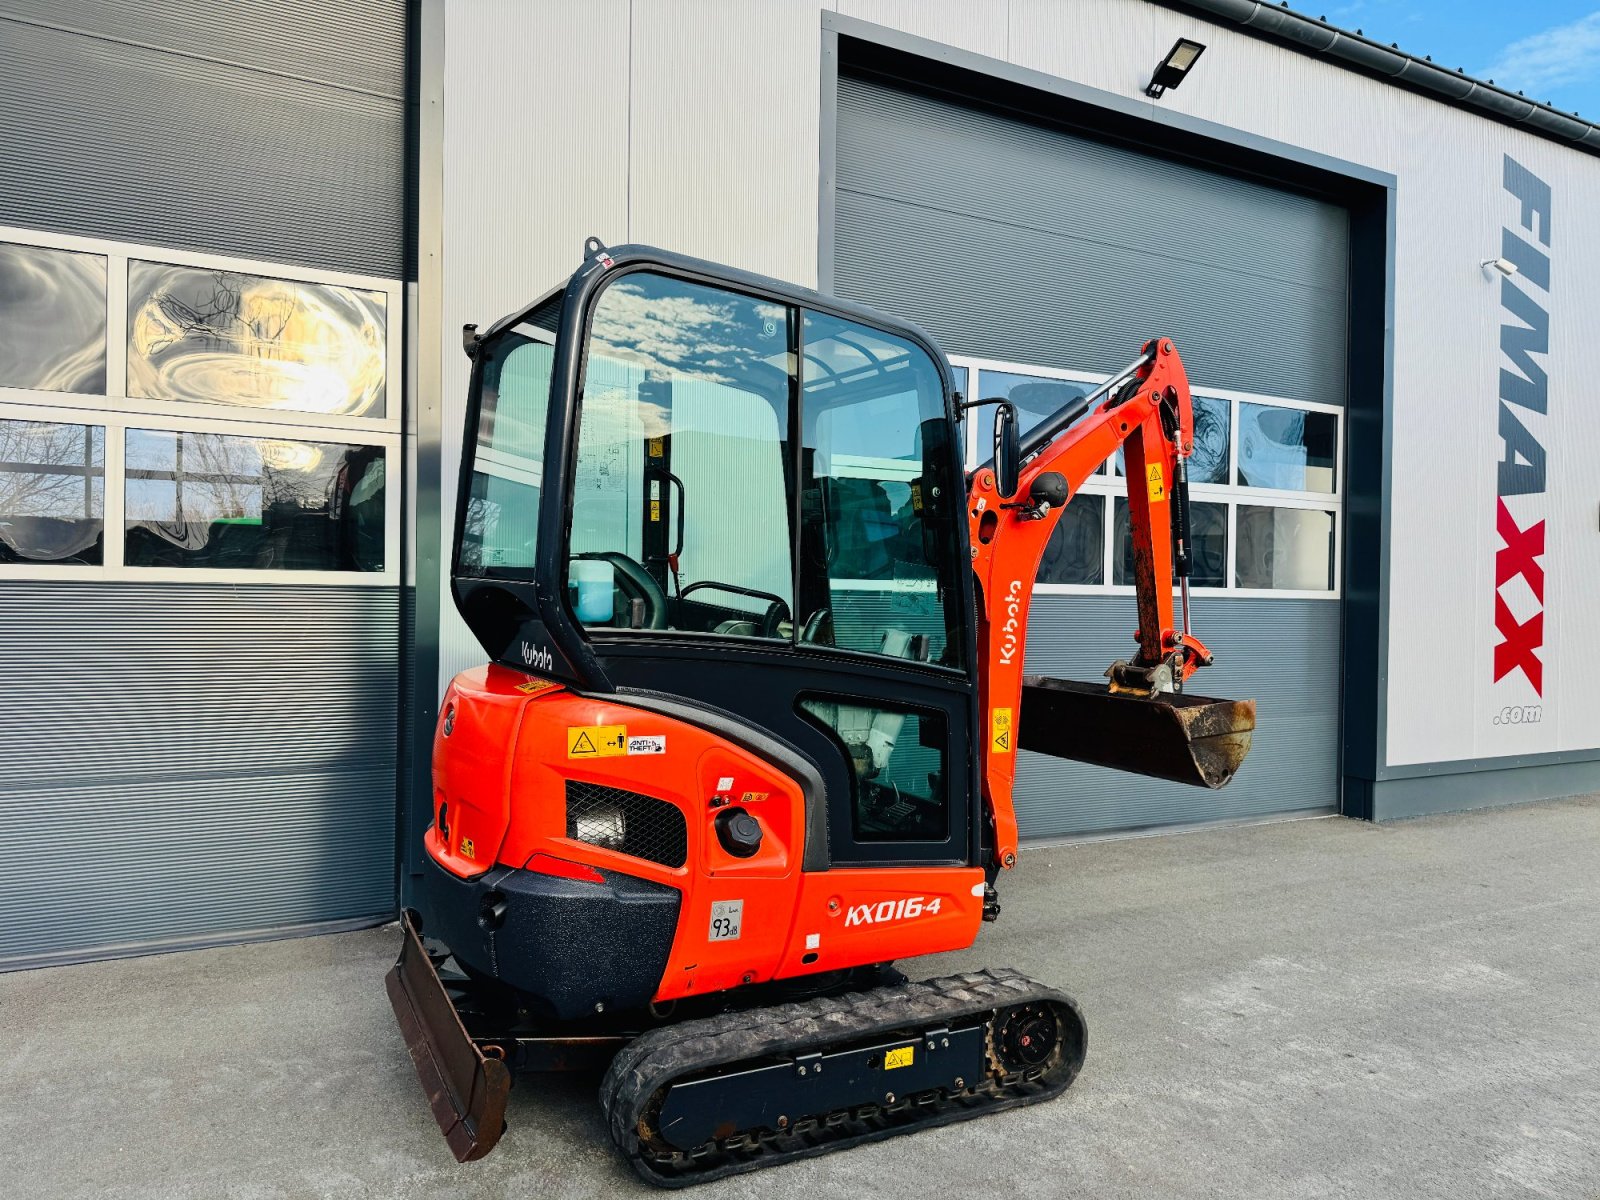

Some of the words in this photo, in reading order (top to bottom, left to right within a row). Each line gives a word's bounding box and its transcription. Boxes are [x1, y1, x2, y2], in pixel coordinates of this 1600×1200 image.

[1493, 152, 1551, 699] FIMAXX
[1000, 580, 1022, 665] Kubota
[521, 640, 553, 671] Kubota
[1493, 705, 1542, 725] .com
[844, 896, 942, 927] KX016-4
[713, 918, 730, 937] 93
[729, 925, 738, 935] dB
